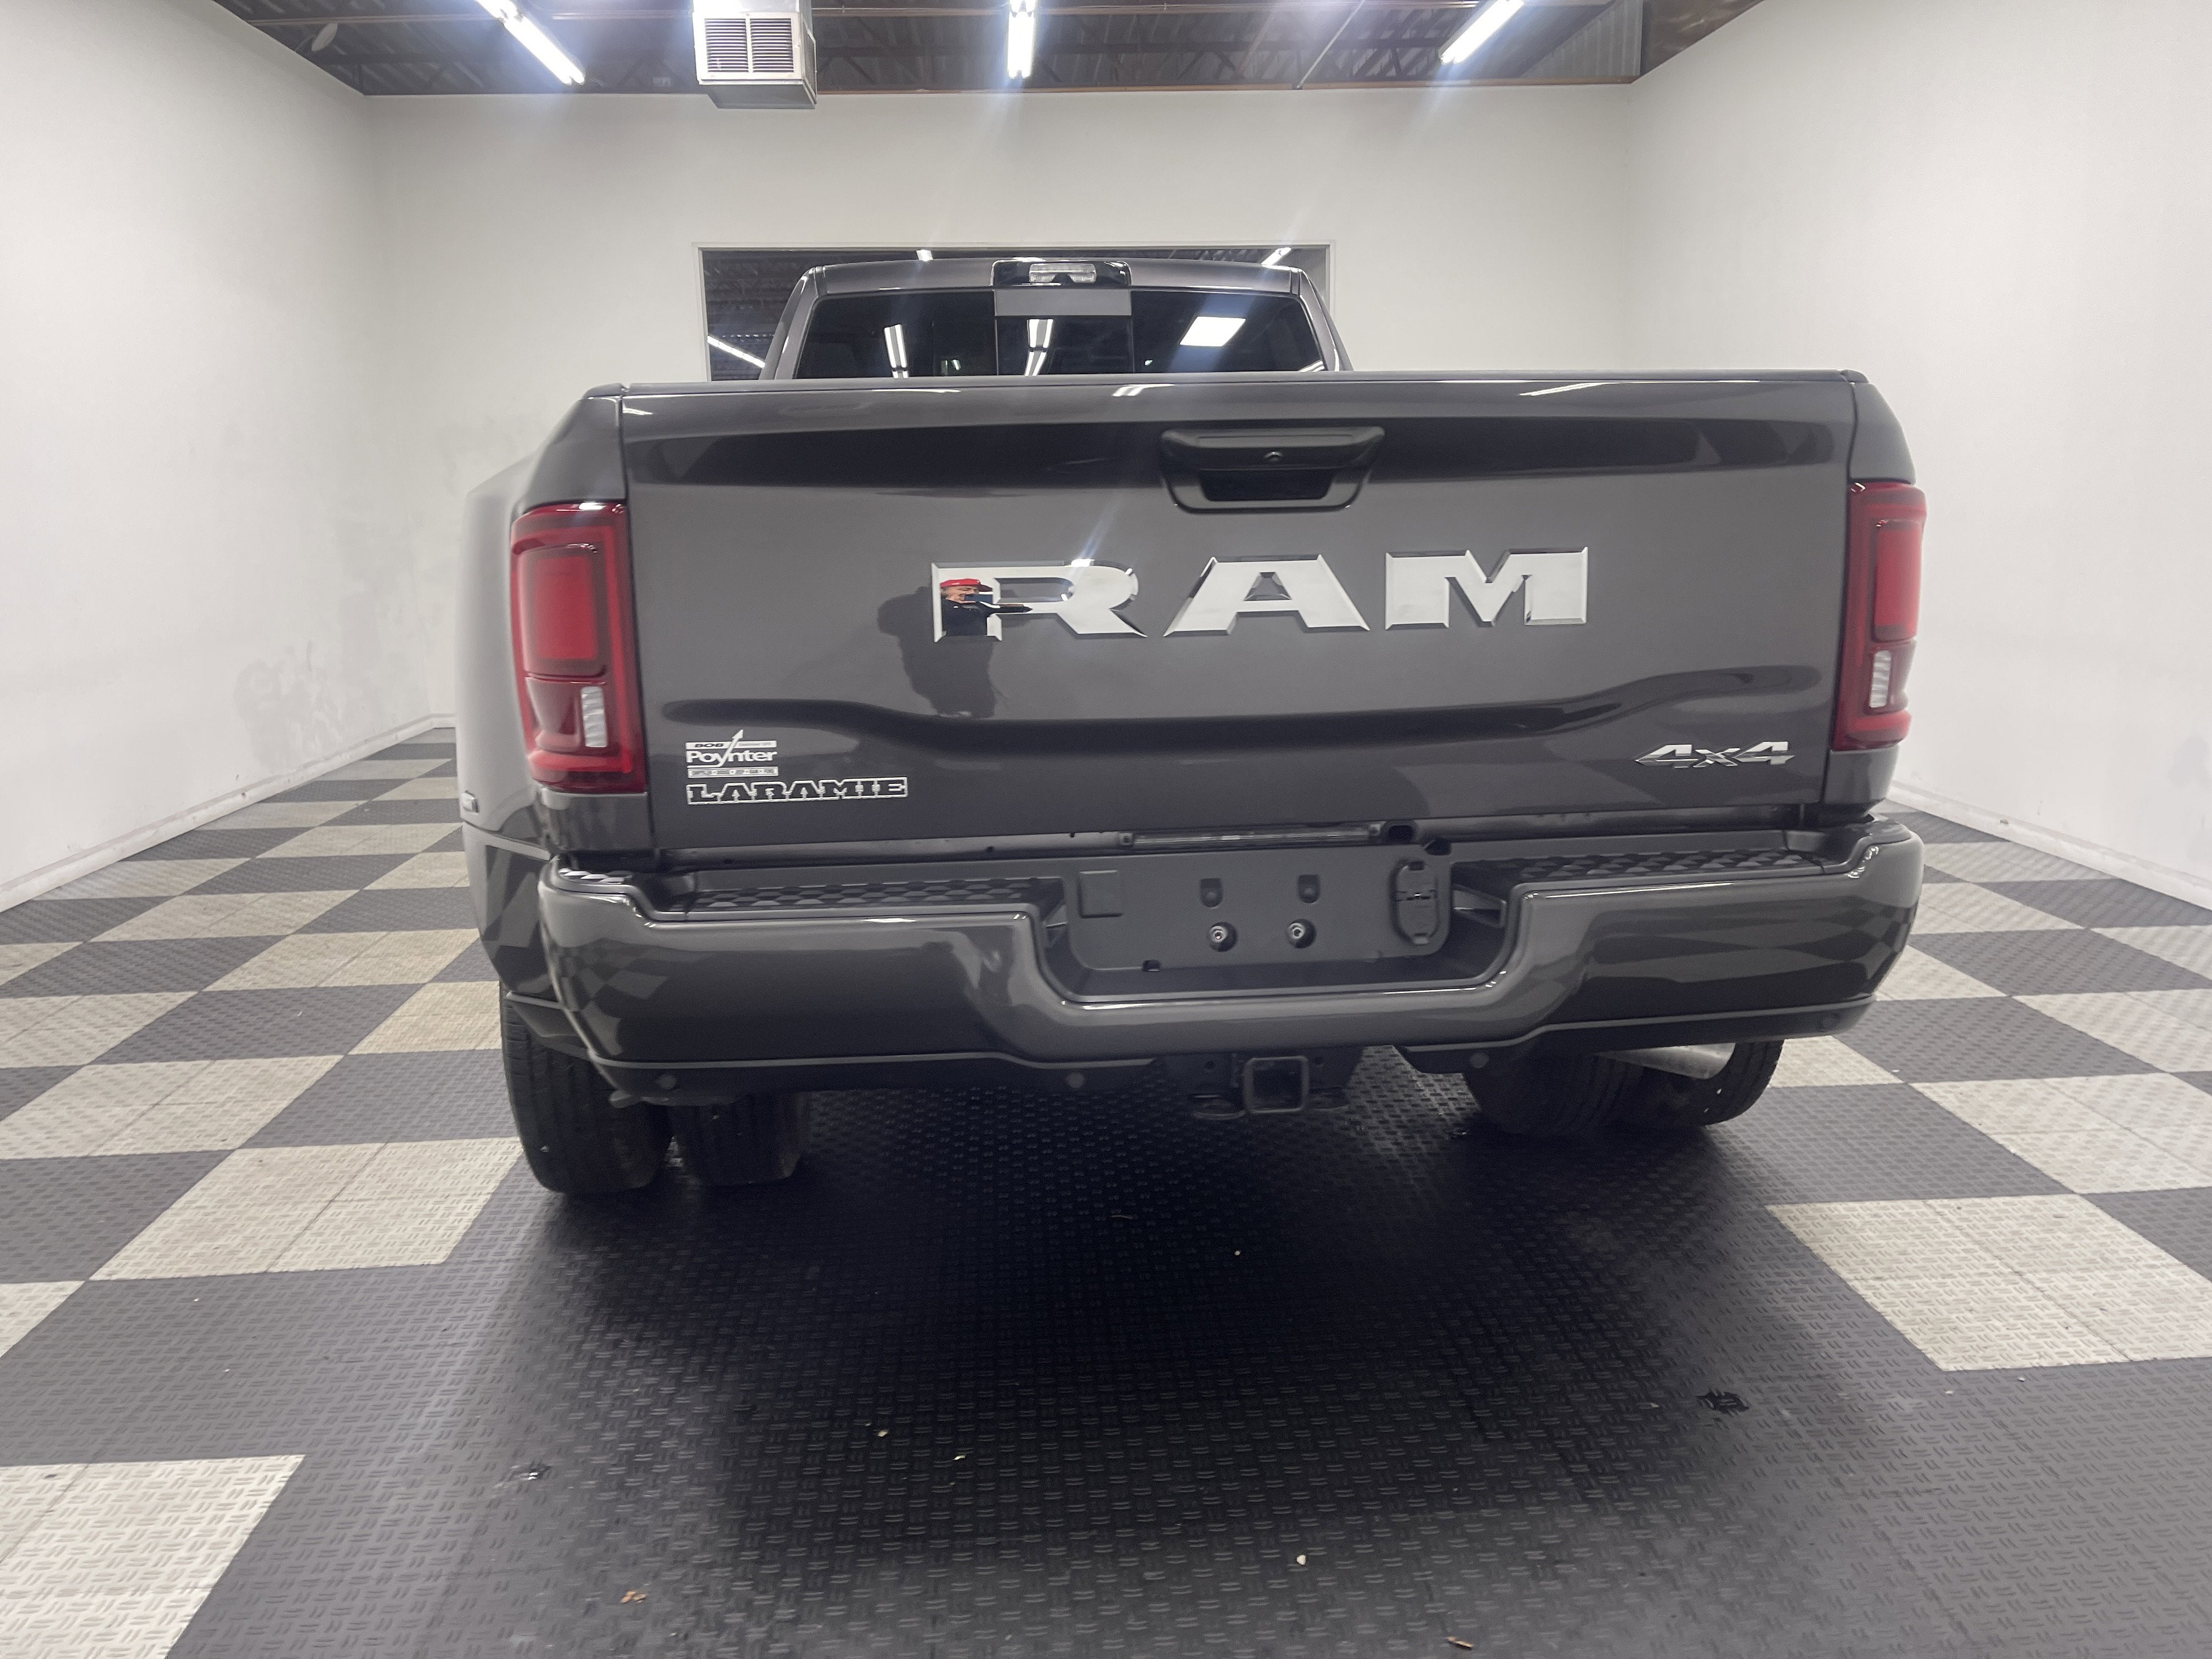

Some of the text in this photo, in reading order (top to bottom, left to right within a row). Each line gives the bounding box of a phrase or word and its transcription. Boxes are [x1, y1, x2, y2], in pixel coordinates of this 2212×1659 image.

[931, 547, 1589, 643] RAM
[686, 749, 777, 767] Poynter
[686, 777, 907, 805] LARAMIE
